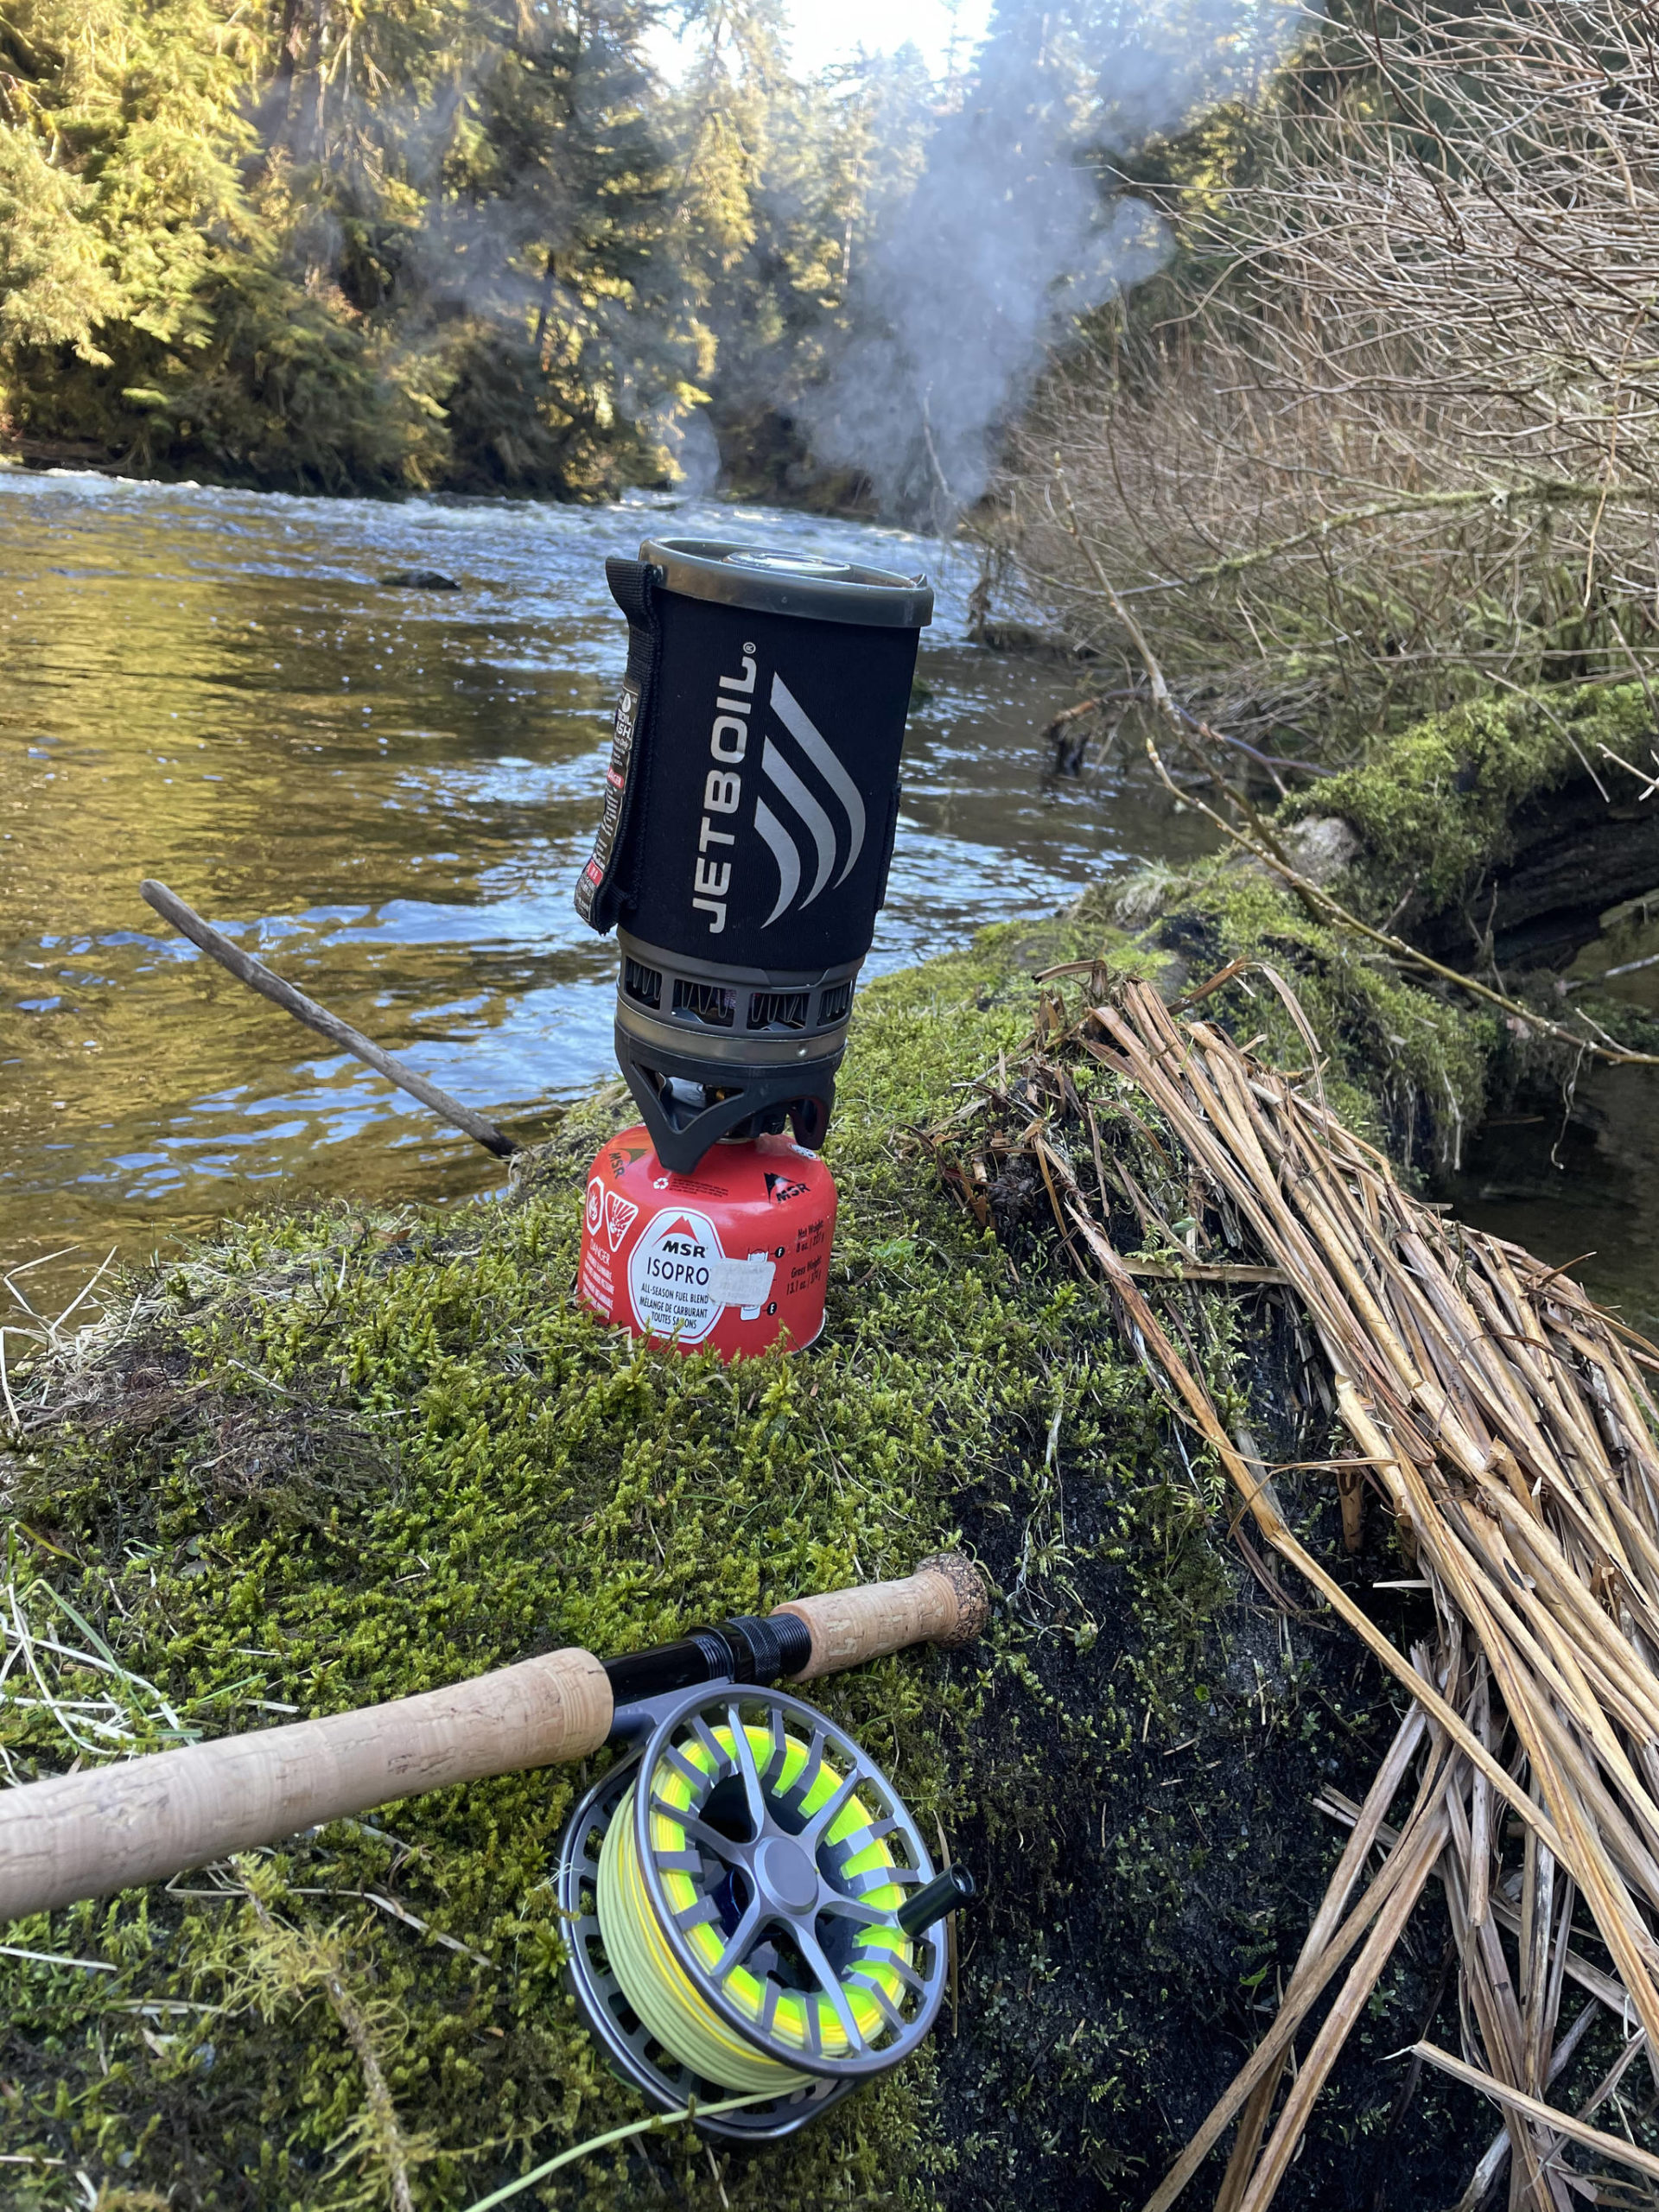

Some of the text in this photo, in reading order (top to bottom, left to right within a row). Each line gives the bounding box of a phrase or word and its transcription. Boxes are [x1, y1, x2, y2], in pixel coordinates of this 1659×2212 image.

[609, 1151, 625, 1179] MSR
[776, 1182, 811, 1204] MSR
[589, 1237, 611, 1267] DANGER
[662, 1240, 706, 1259] MSR
[646, 1256, 710, 1286] ISOPRO
[640, 1282, 709, 1305] ALL-SEASON FUEL BLEND
[651, 1311, 671, 1325] TOUTES
[664, 1303, 672, 1313] DE
[673, 1305, 709, 1319] CARBURANT
